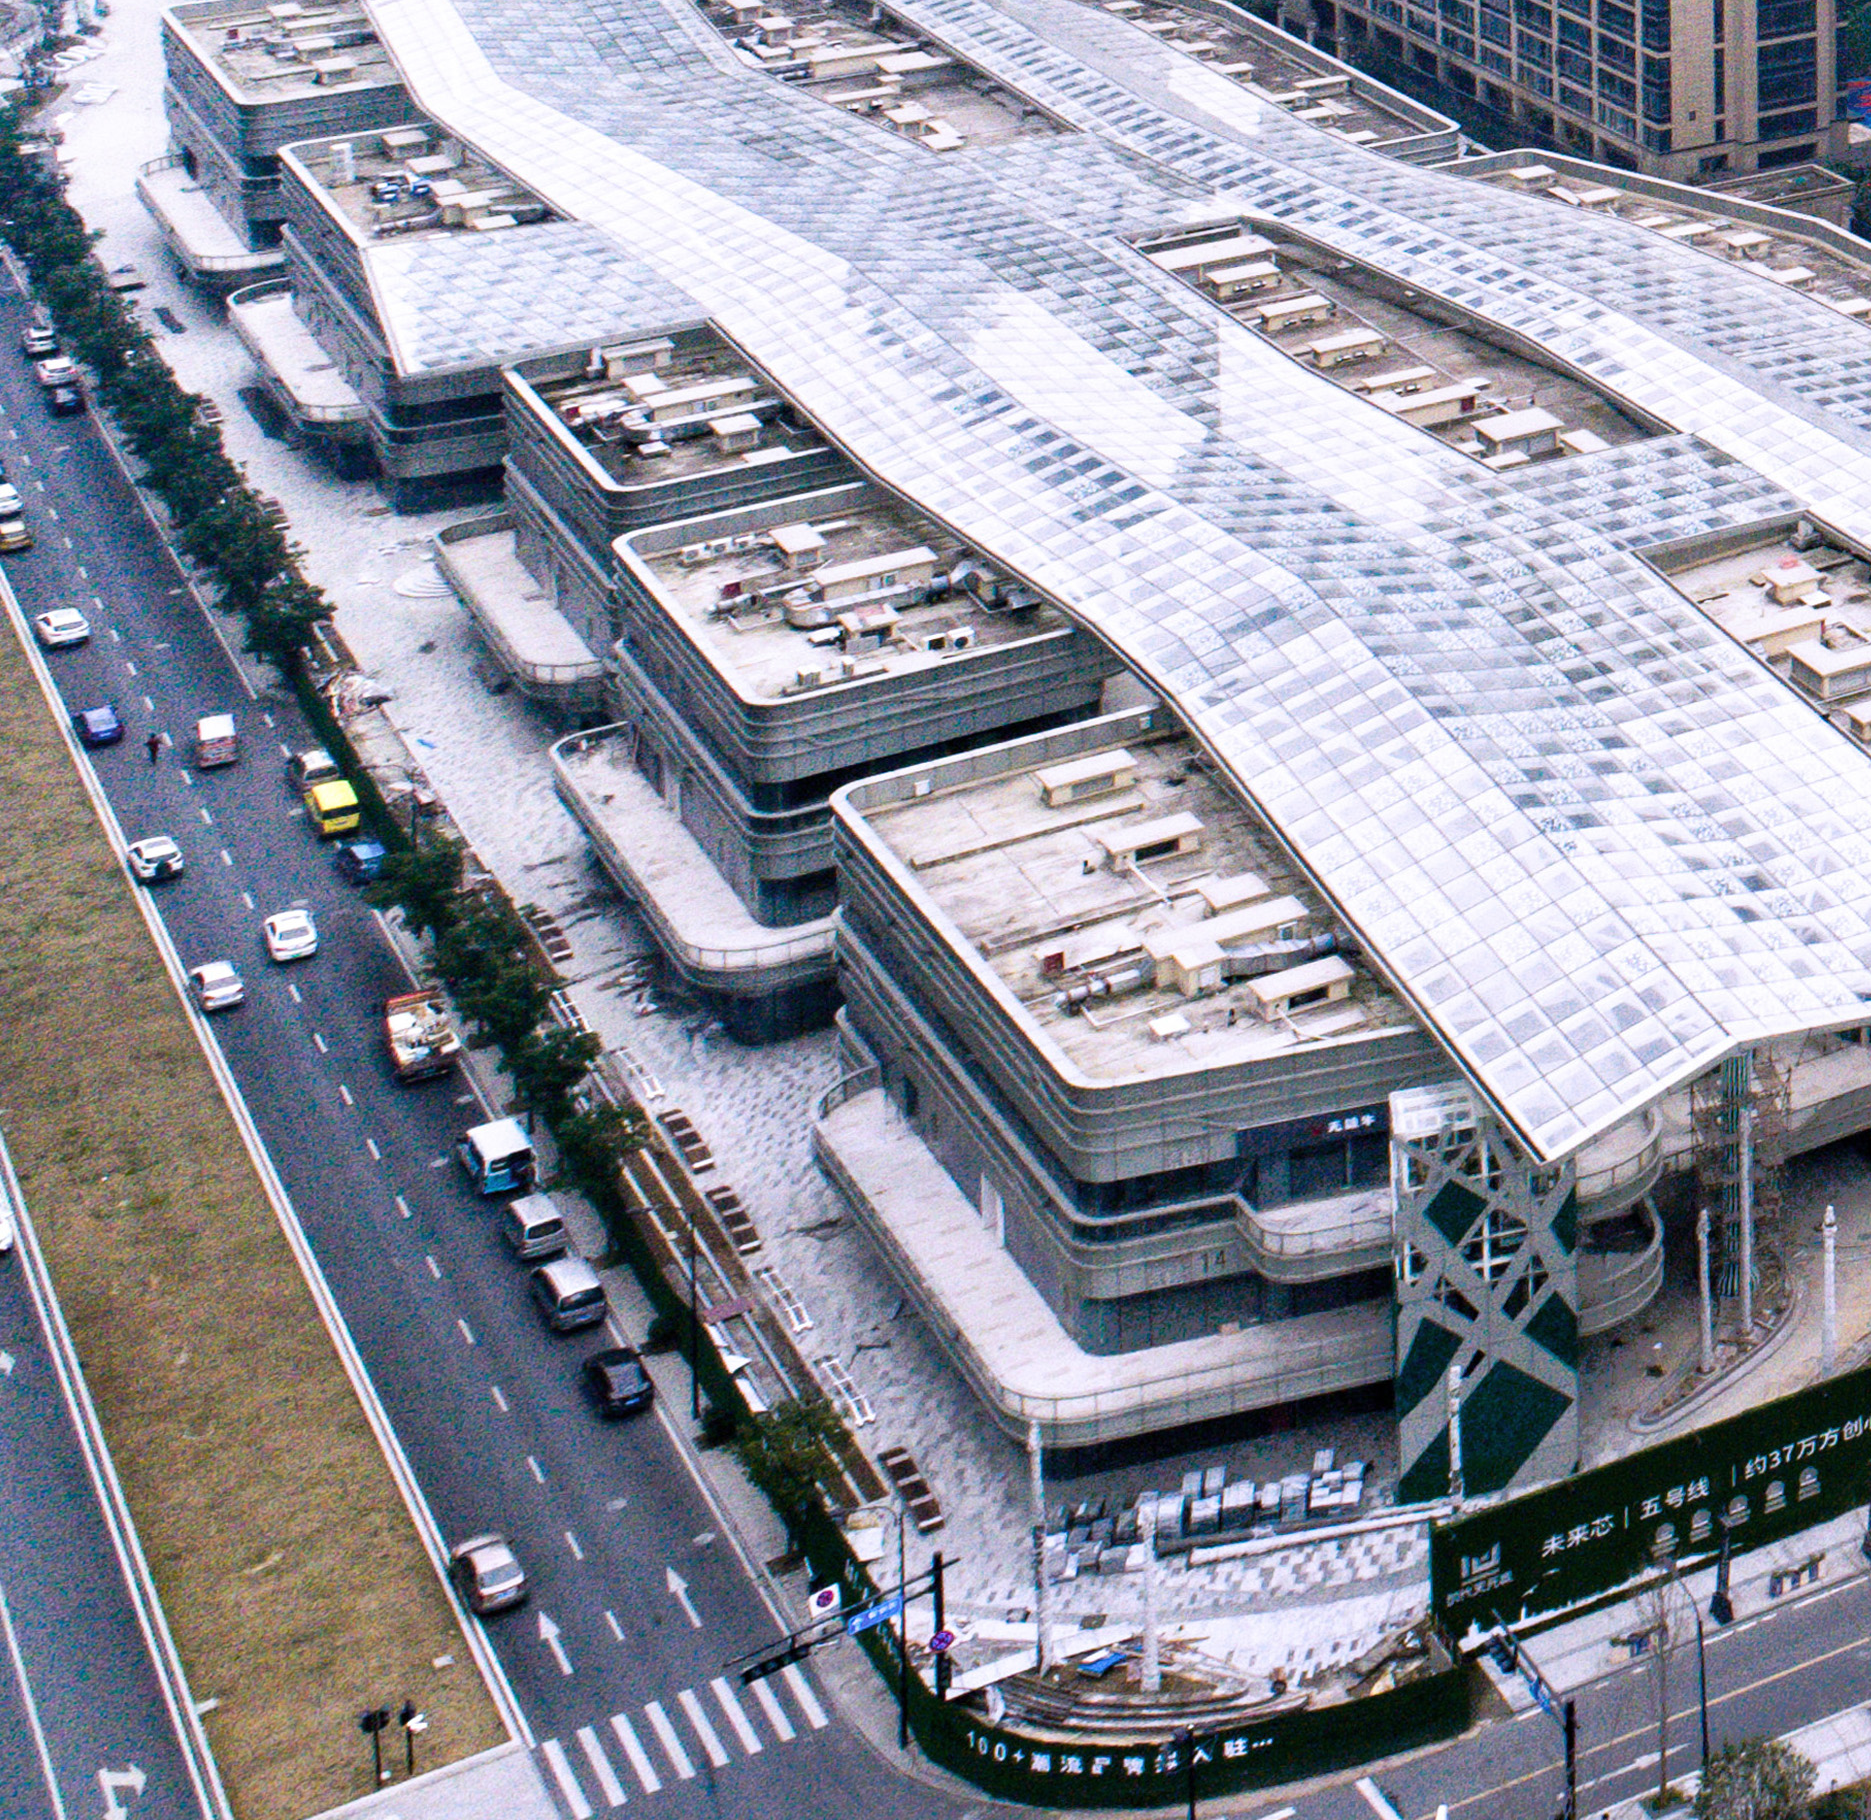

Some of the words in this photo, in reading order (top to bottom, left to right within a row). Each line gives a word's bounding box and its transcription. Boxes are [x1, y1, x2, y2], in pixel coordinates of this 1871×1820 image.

[1541, 1514, 1615, 1557] 未来芯
[1639, 1475, 1710, 1521] 五号线
